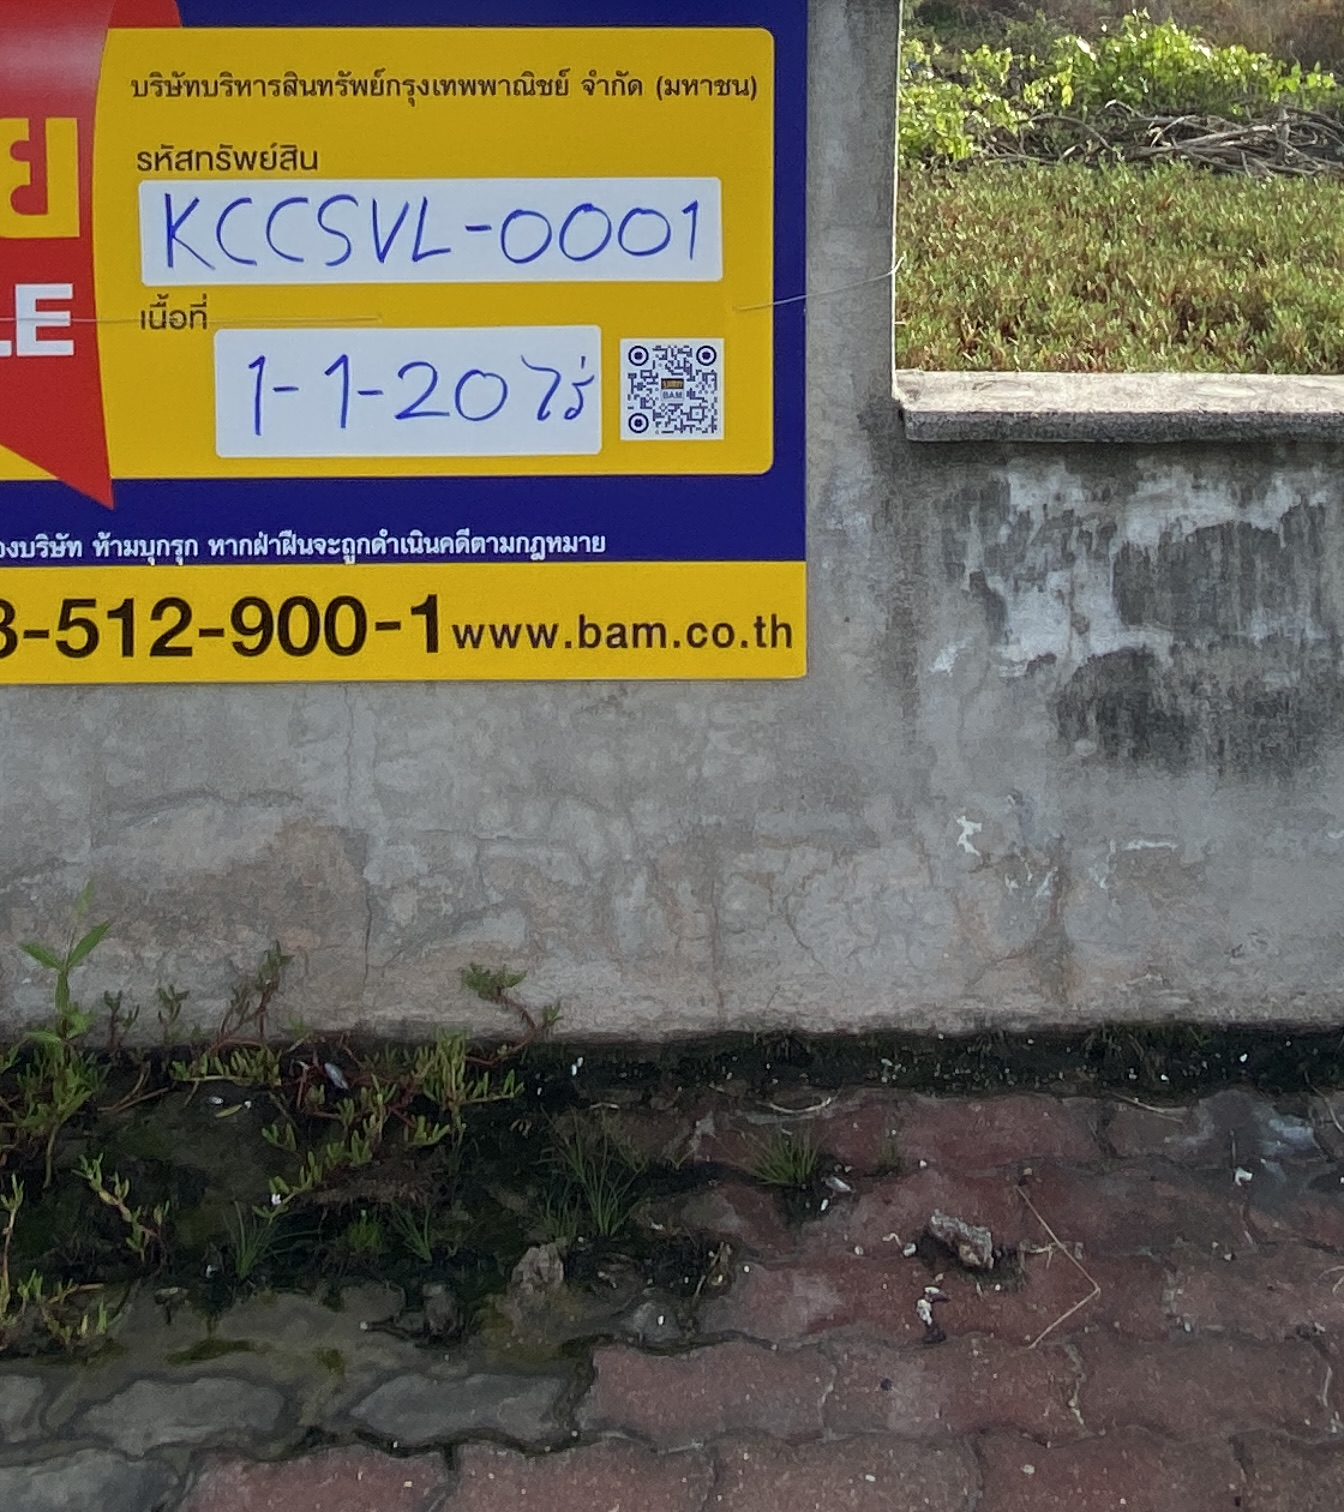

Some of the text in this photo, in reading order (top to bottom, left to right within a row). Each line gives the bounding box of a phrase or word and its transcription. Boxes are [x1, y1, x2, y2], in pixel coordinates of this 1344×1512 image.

[131, 68, 757, 107] บริษัทบริหารสินทรัพย์กรุงเทพพาณิชย์ จำกัด (มหาชน)
[137, 143, 318, 171] รหัสทรัพย์สิน
[164, 192, 699, 271] KCCSVL-0001
[140, 293, 208, 330] เนื้อที่
[92, 532, 199, 566] ห้ามบุกรุก
[208, 529, 607, 564] หากฝ่าฝืนจะถูกดำเนินคดีตามกฎหมาย
[452, 614, 793, 649] www.bam.co.th
